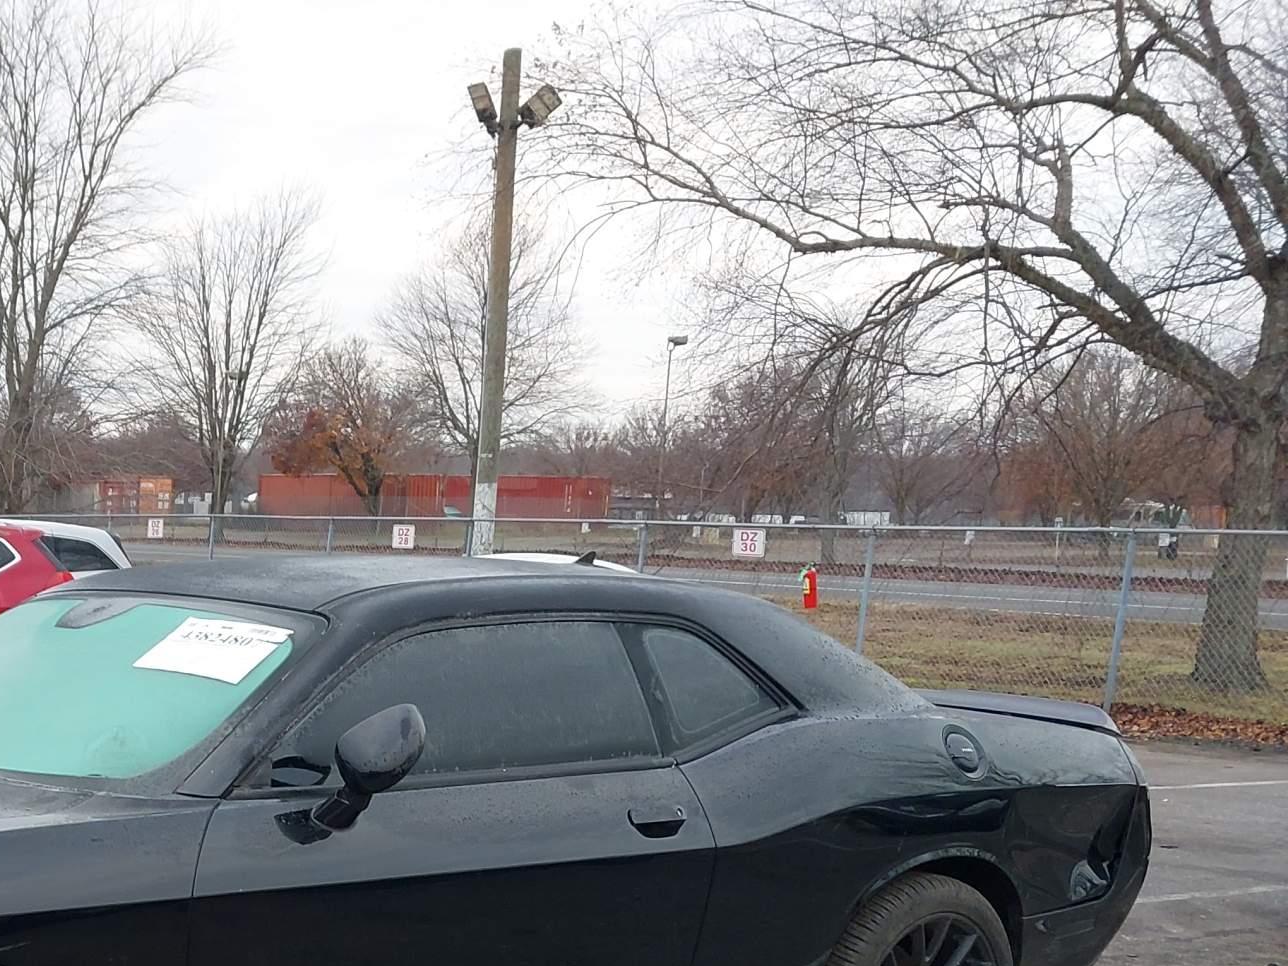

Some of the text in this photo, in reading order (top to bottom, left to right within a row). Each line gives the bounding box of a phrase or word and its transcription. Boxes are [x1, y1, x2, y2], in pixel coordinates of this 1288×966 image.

[398, 528, 410, 536] DZ
[740, 531, 759, 542] DZ
[398, 537, 409, 545] 28
[740, 542, 757, 553] 30
